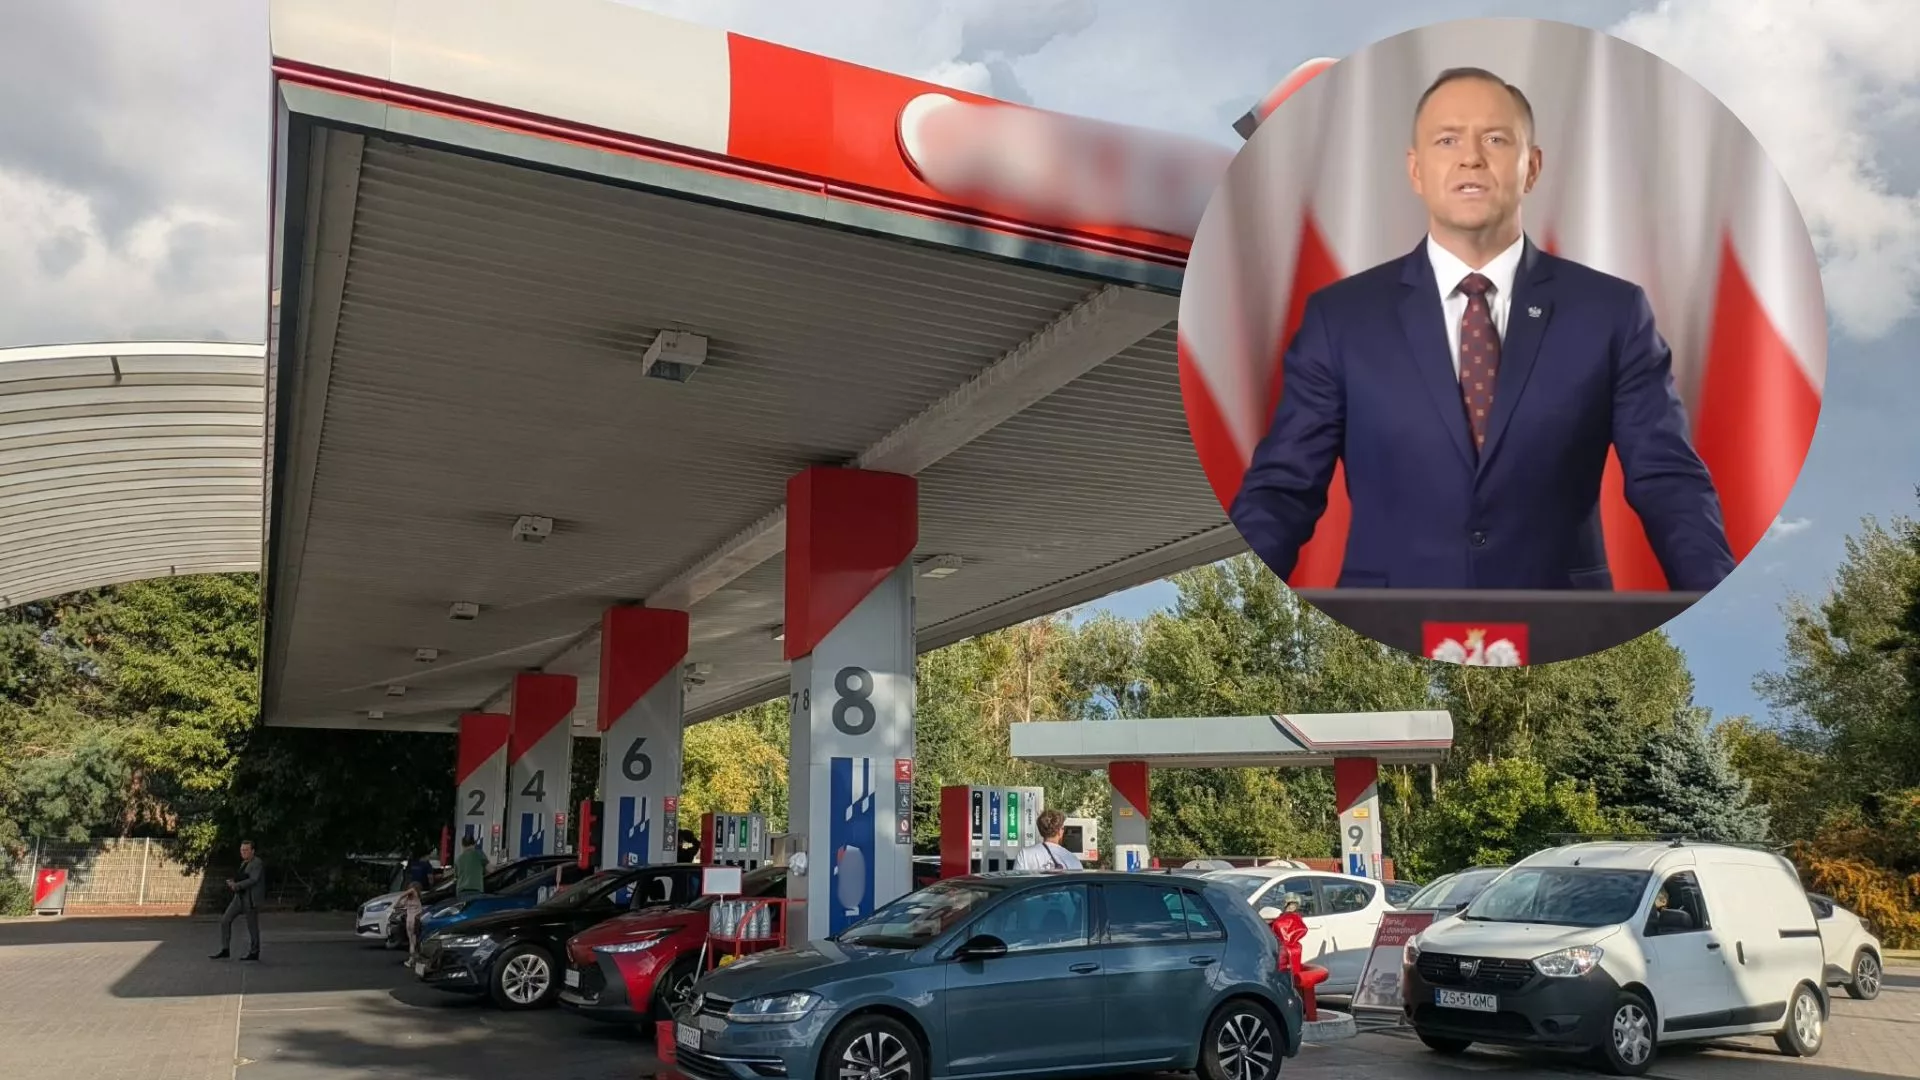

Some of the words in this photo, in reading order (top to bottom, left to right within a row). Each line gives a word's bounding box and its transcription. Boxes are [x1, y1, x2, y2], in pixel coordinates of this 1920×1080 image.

[792, 692, 799, 715] 7
[803, 688, 810, 711] 8
[832, 666, 876, 736] 8
[622, 737, 652, 781] 6
[520, 770, 546, 802] 4
[466, 789, 486, 816] 2
[1348, 825, 1363, 847] 9
